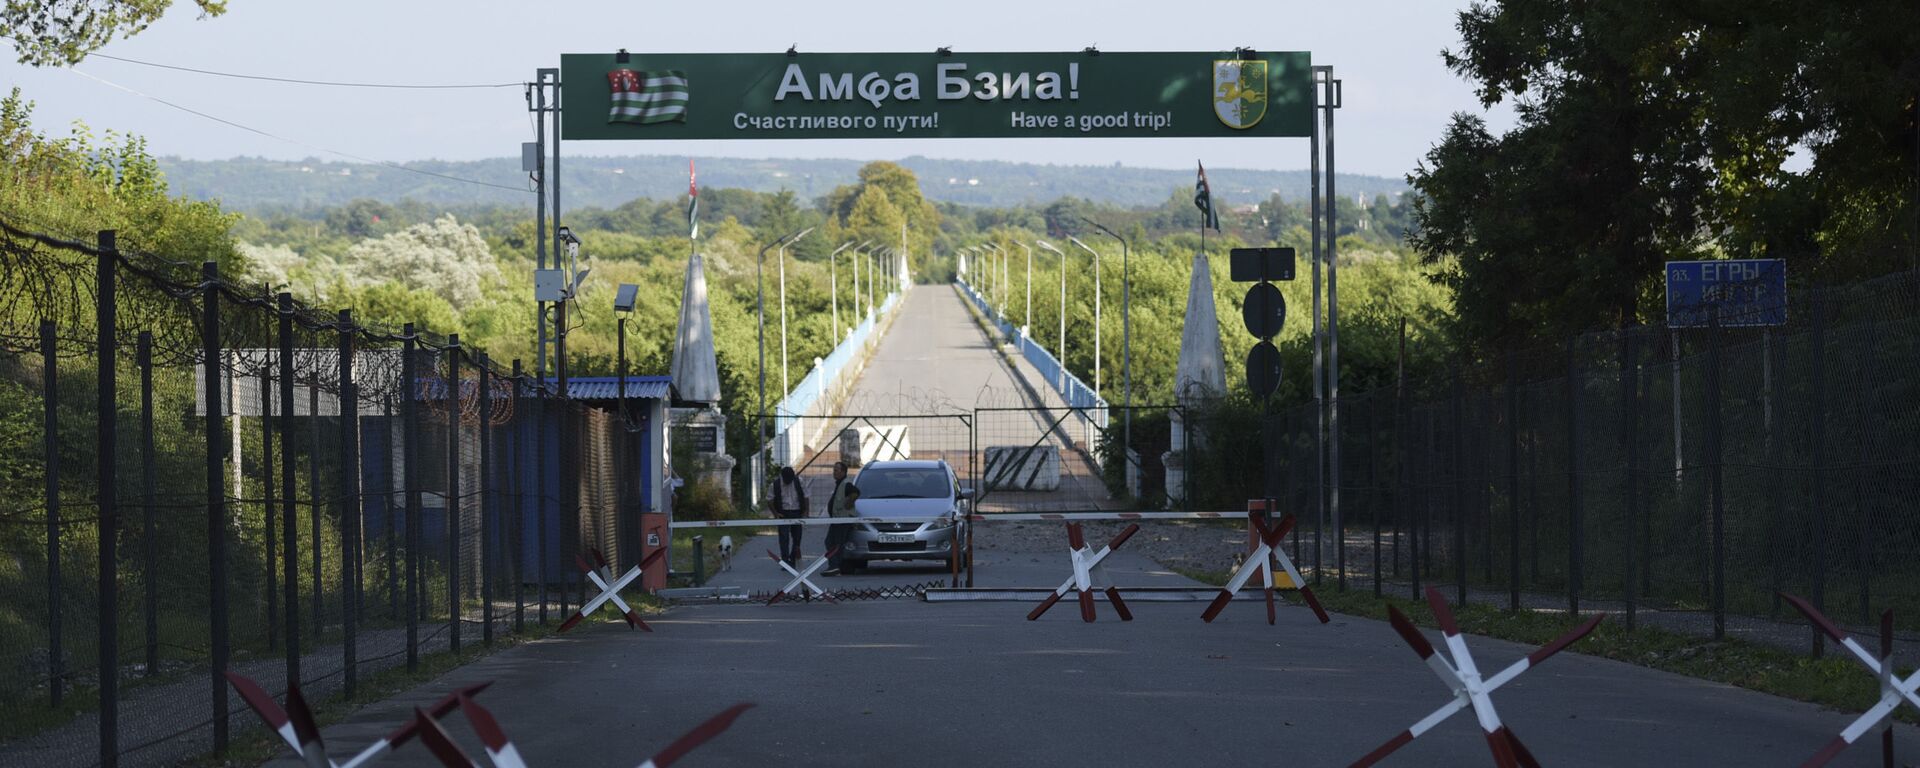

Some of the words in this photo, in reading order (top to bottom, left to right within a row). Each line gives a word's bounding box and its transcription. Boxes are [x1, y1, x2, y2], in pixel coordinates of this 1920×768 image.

[936, 62, 1080, 101] Бзиа!
[733, 112, 877, 130] Счастливого
[883, 111, 939, 132] пути!
[1011, 111, 1059, 128] Have
[1064, 115, 1076, 128] a
[1080, 111, 1129, 132] good
[1134, 111, 1172, 131] trip!
[1701, 262, 1760, 281] ЕГРЫ
